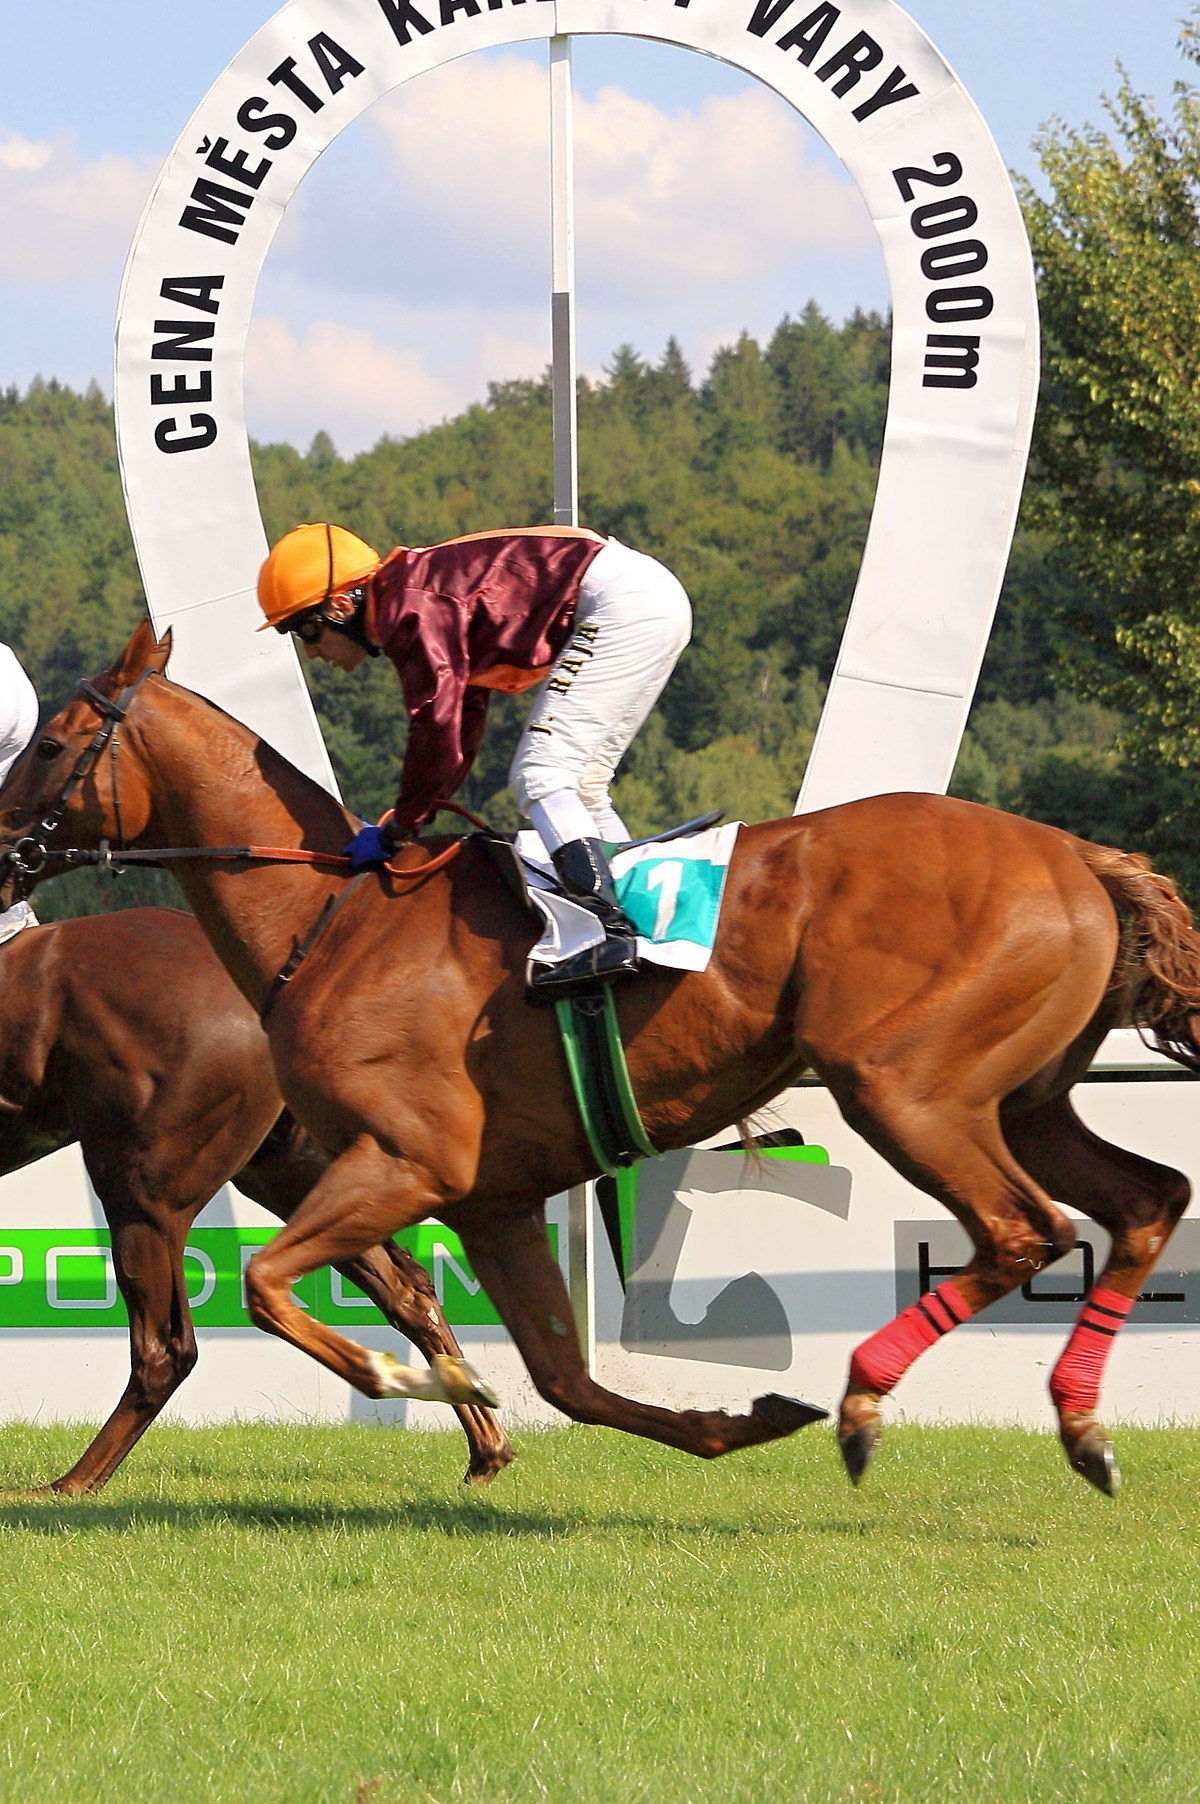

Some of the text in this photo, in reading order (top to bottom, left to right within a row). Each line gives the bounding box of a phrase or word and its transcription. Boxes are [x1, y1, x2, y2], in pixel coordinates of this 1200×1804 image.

[150, 0, 994, 454] CENA MĚSTA VARY 2000m
[546, 623, 601, 696] RAJA
[646, 860, 684, 942] 1
